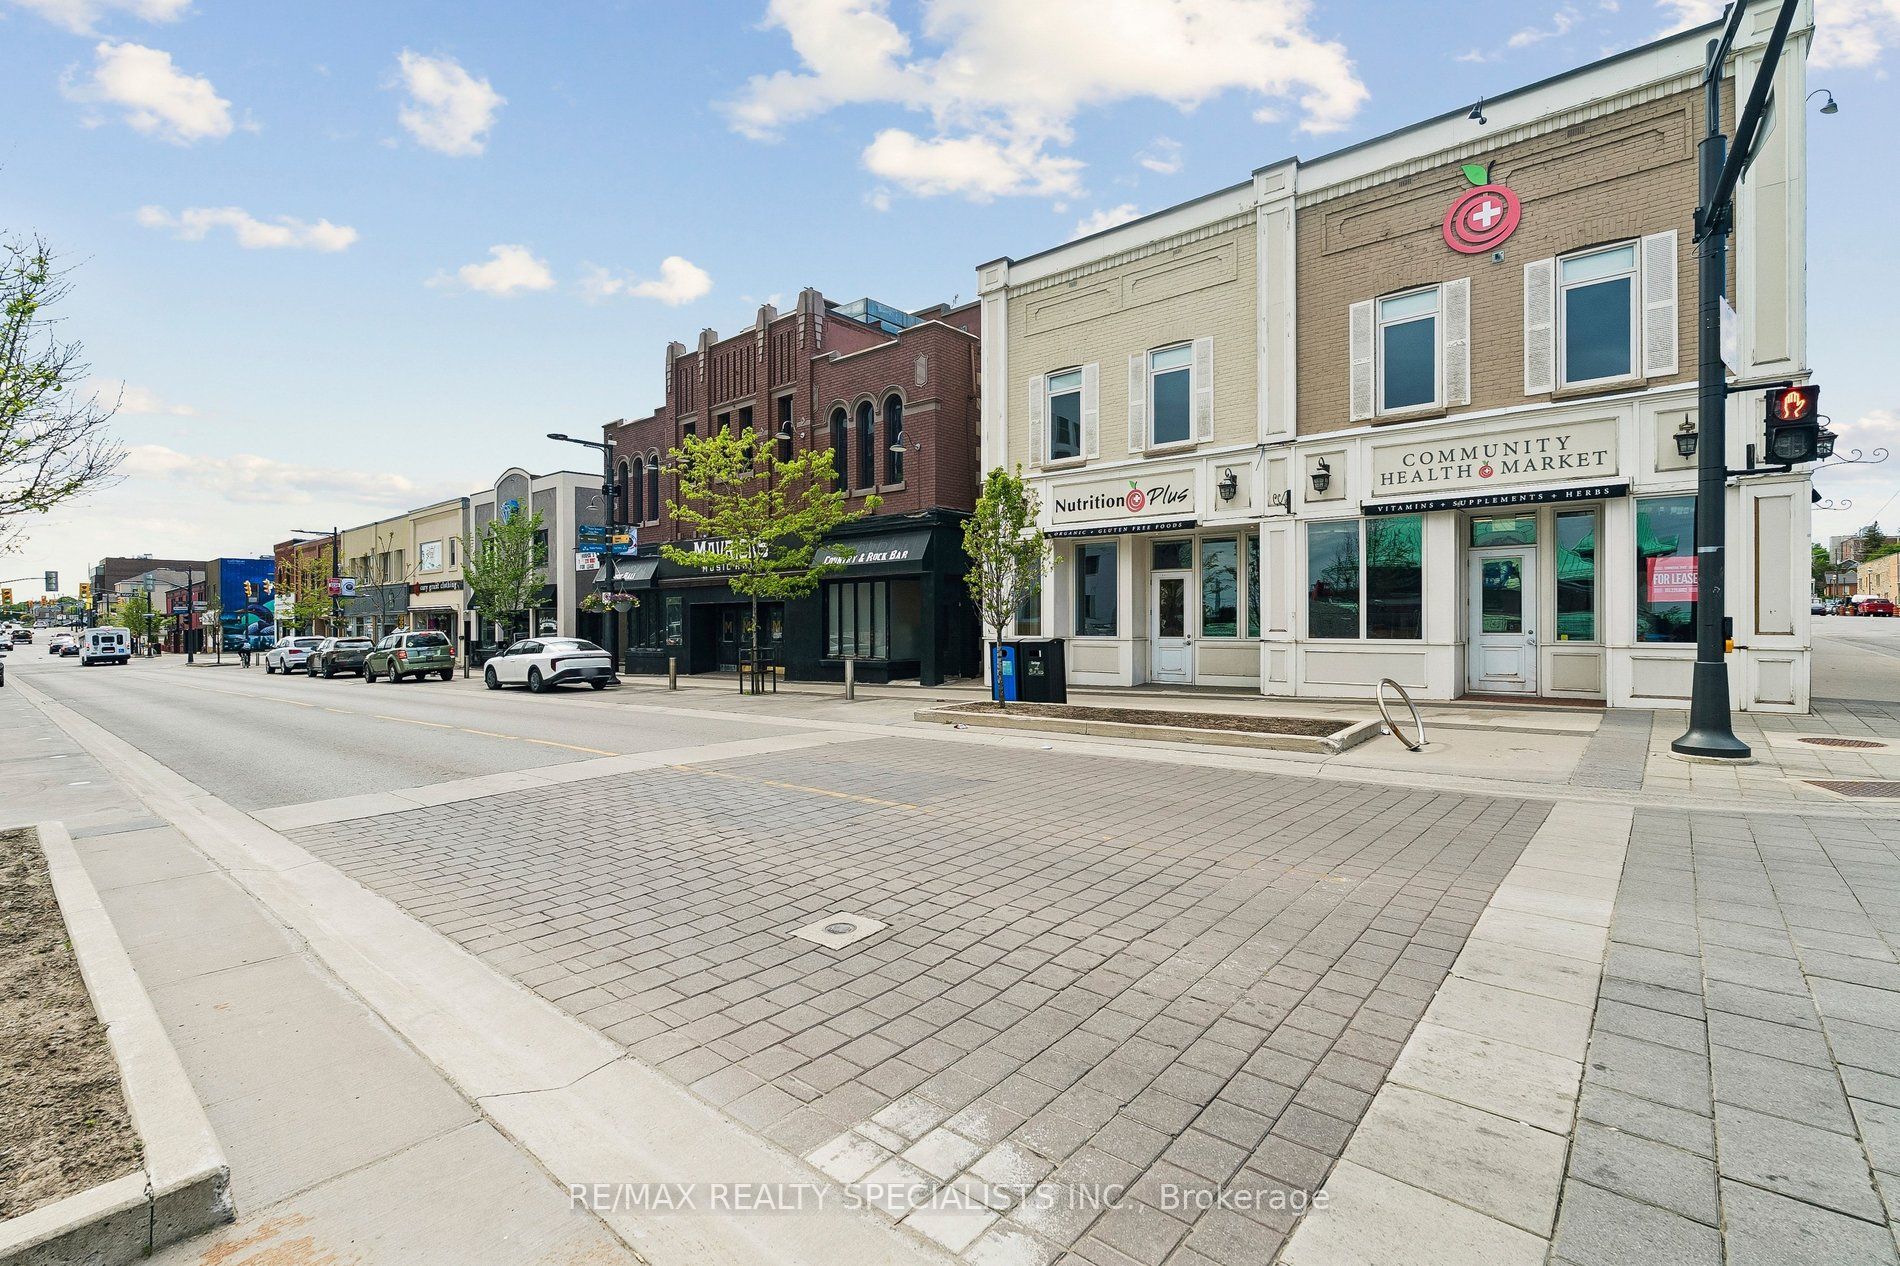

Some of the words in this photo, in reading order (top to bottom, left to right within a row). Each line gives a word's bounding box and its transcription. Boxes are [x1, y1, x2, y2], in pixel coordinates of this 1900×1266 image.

[1402, 435, 1572, 467] COMMUNITY
[1380, 464, 1472, 486] HEALTH
[1500, 449, 1608, 475] MARKET
[1055, 493, 1125, 513] Nutrition
[1146, 484, 1190, 506] Plus
[1377, 502, 1434, 512] VITAMINS
[1452, 493, 1544, 507] SUPPLEMENTS
[1565, 487, 1611, 498] HERBS
[1053, 529, 1087, 537] ORGANIC
[1097, 526, 1128, 534] GLUTEN
[1155, 522, 1183, 530] FOODS
[1653, 573, 1670, 585] FOR
[1671, 572, 1698, 585] LEASE
